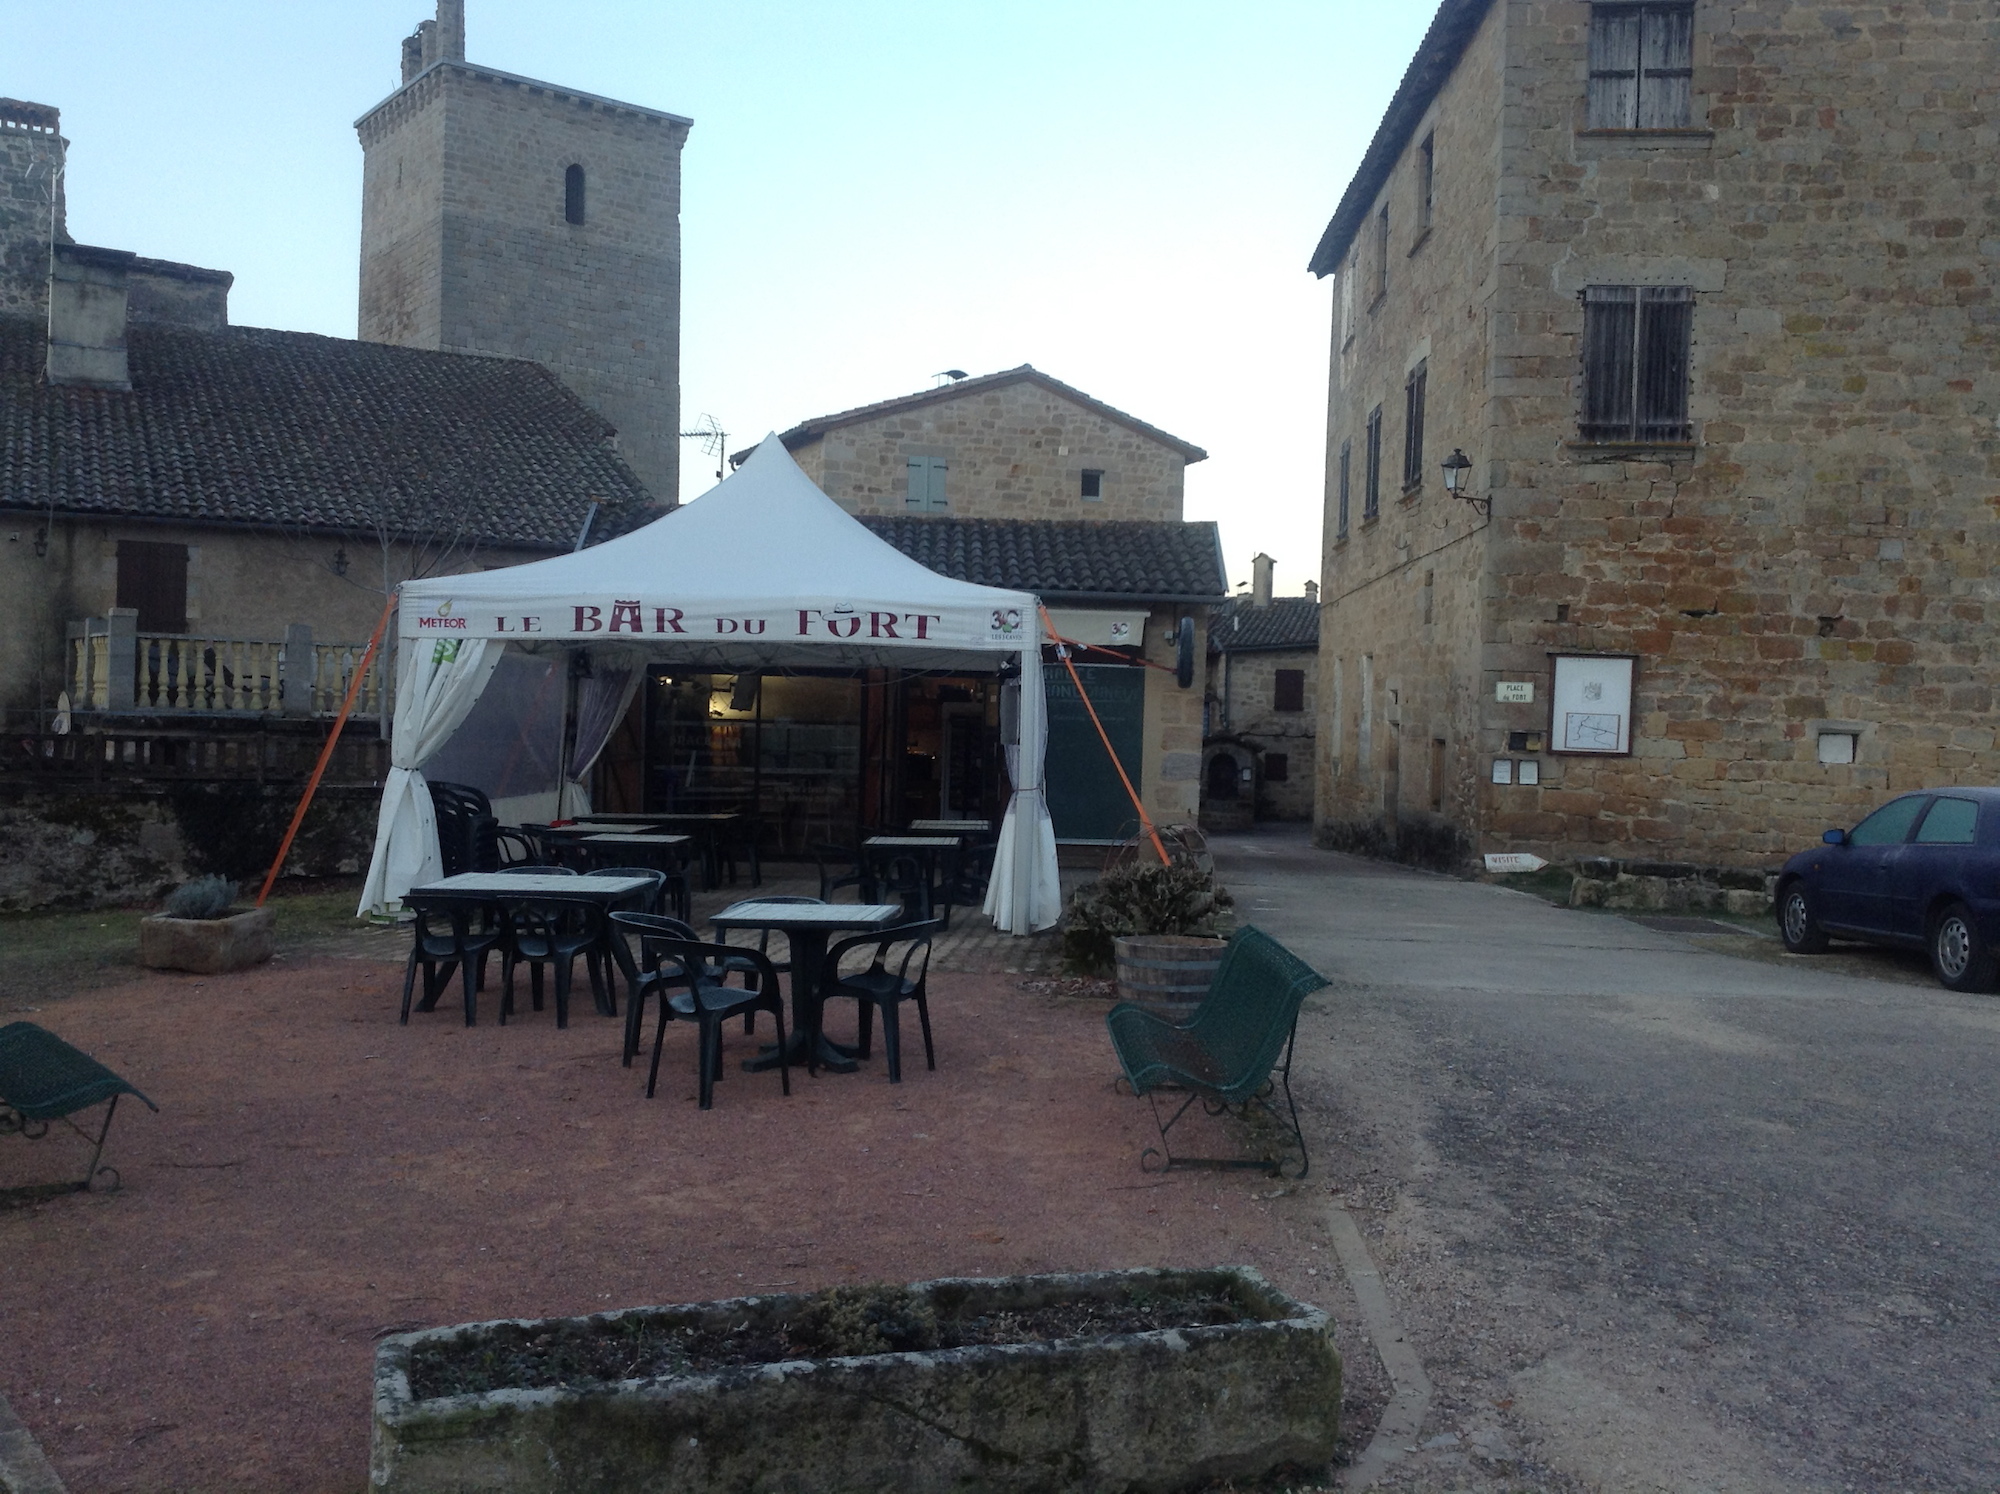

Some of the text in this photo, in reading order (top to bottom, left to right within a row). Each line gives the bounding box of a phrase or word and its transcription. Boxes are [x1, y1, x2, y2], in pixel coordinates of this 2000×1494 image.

[418, 617, 467, 629] METEOR
[494, 600, 942, 640] LE BAR DU FORT
[1492, 856, 1521, 864] VISITE
